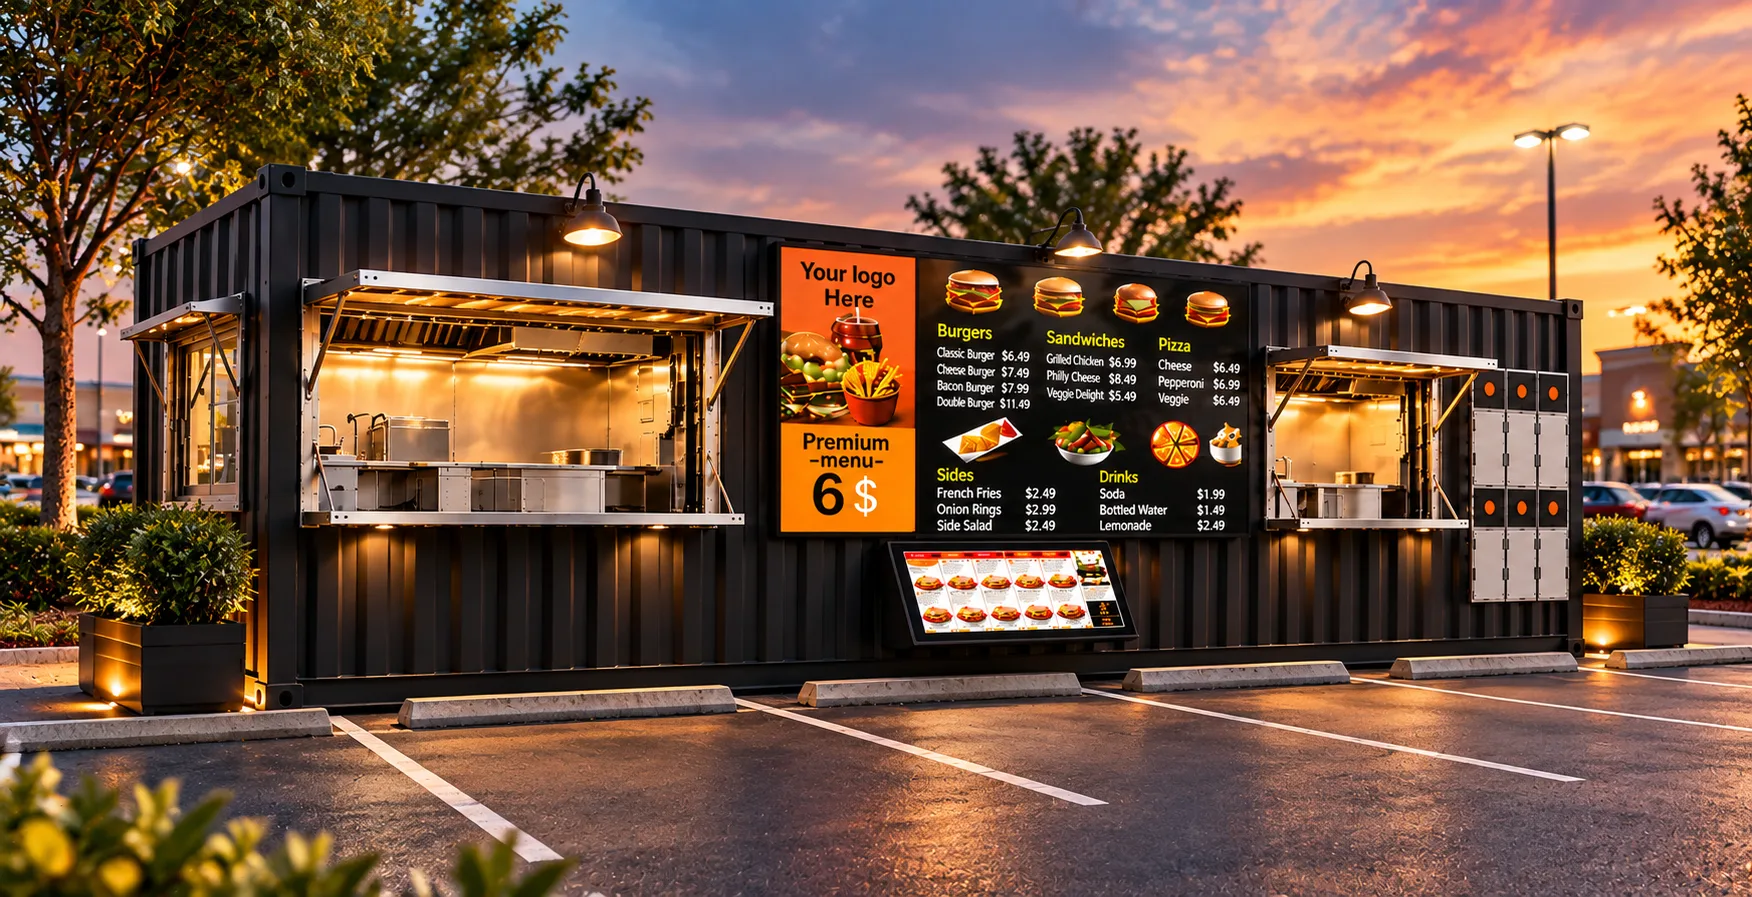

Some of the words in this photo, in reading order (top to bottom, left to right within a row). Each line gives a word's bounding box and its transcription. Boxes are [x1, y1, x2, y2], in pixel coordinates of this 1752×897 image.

[801, 262, 848, 283] Your
[853, 265, 896, 289] logo
[825, 289, 875, 309] Here
[938, 323, 993, 342] Burgers
[1047, 330, 1125, 349] Sandwiches
[1159, 337, 1191, 353] Pizza
[937, 347, 965, 359] Classic
[967, 349, 996, 363] Burger
[1002, 350, 1031, 363] $6.49
[1047, 353, 1072, 366] Grilled
[1073, 355, 1105, 367] Chicken
[1109, 356, 1137, 369] $6.99
[937, 364, 967, 376] Cheese
[968, 365, 996, 380] Burger
[1002, 366, 1030, 379] $7.49
[1158, 359, 1193, 372] Cheese
[1214, 362, 1241, 374] $6.49
[1047, 370, 1069, 384] Philly
[1071, 372, 1101, 384] Cheese
[1109, 373, 1137, 386] $8.49
[1159, 376, 1205, 391] Pepperoni
[1213, 378, 1241, 391] $6.99
[937, 380, 964, 392] Bacon
[966, 382, 995, 396] Burger
[1002, 383, 1030, 394] $7.99
[1047, 387, 1074, 402] Veggie
[1075, 389, 1105, 403] Delight
[1109, 390, 1137, 402] $5.49
[937, 396, 967, 408] Double
[968, 397, 996, 411] Burger
[1000, 398, 1031, 410] $11.49
[1158, 393, 1190, 407] Veggie
[1213, 395, 1241, 407] $6.49
[804, 433, 889, 451] Premium
[937, 468, 975, 482] Sides
[1100, 470, 1139, 484] Drinks
[813, 473, 845, 516] 6
[854, 476, 878, 518] $
[938, 487, 974, 499] French
[977, 487, 1002, 499] Fries
[1026, 487, 1057, 500] $2.49
[1100, 488, 1126, 500] Soda
[1197, 488, 1226, 501] $1.99
[937, 504, 970, 515] Onion
[973, 504, 1002, 519] Rings
[1026, 504, 1057, 516] $2.99
[1100, 504, 1136, 516] Bottled
[1139, 505, 1168, 516] Water
[1197, 504, 1226, 517] $1.49
[937, 519, 961, 532] Side
[964, 519, 993, 532] Salad
[1026, 520, 1056, 532] $2.49
[1100, 520, 1152, 532] Lemonade
[1198, 520, 1226, 532] $2.49
